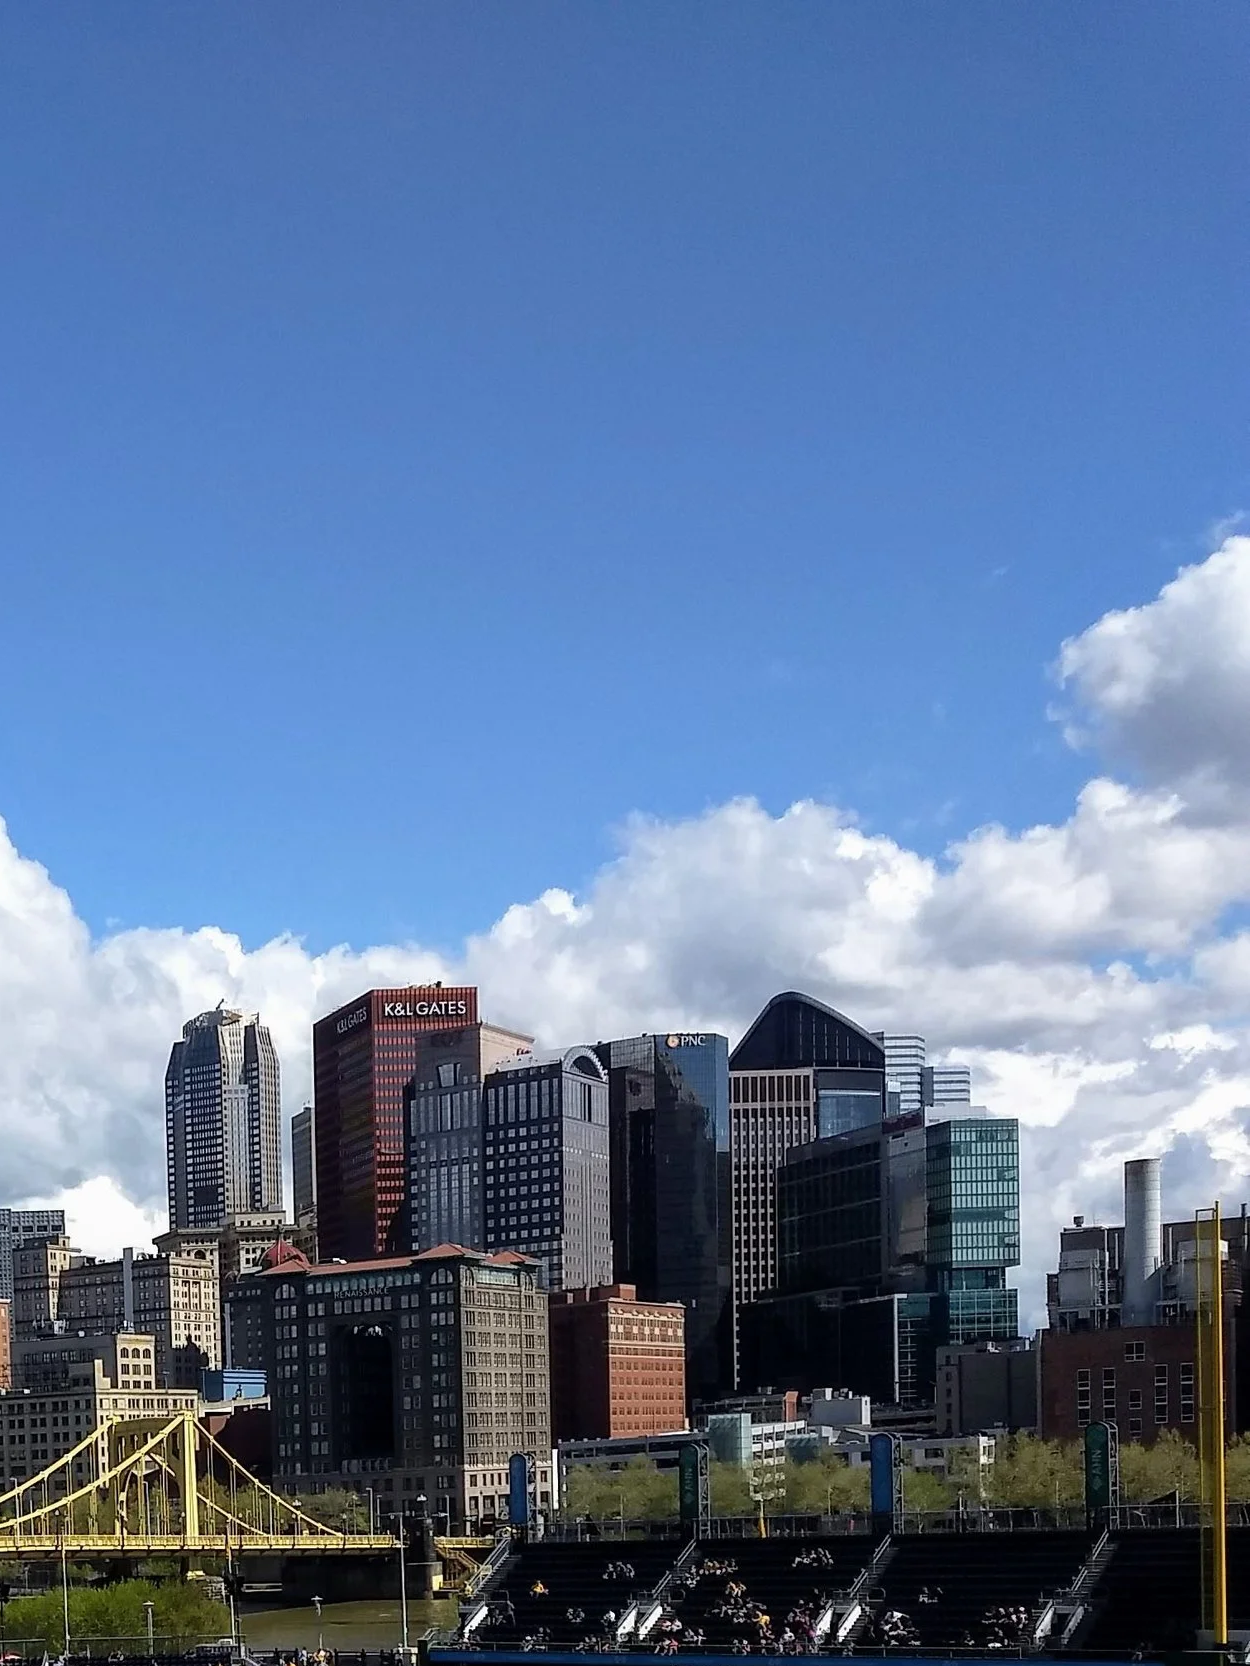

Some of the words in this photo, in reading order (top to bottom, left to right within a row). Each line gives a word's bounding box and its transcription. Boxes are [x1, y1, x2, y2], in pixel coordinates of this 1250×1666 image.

[384, 1002, 413, 1017] K&L
[415, 1001, 467, 1016] GATES
[348, 1007, 367, 1028] GATES
[681, 1035, 707, 1047] PNC
[334, 1286, 390, 1299] RENAISSANCE
